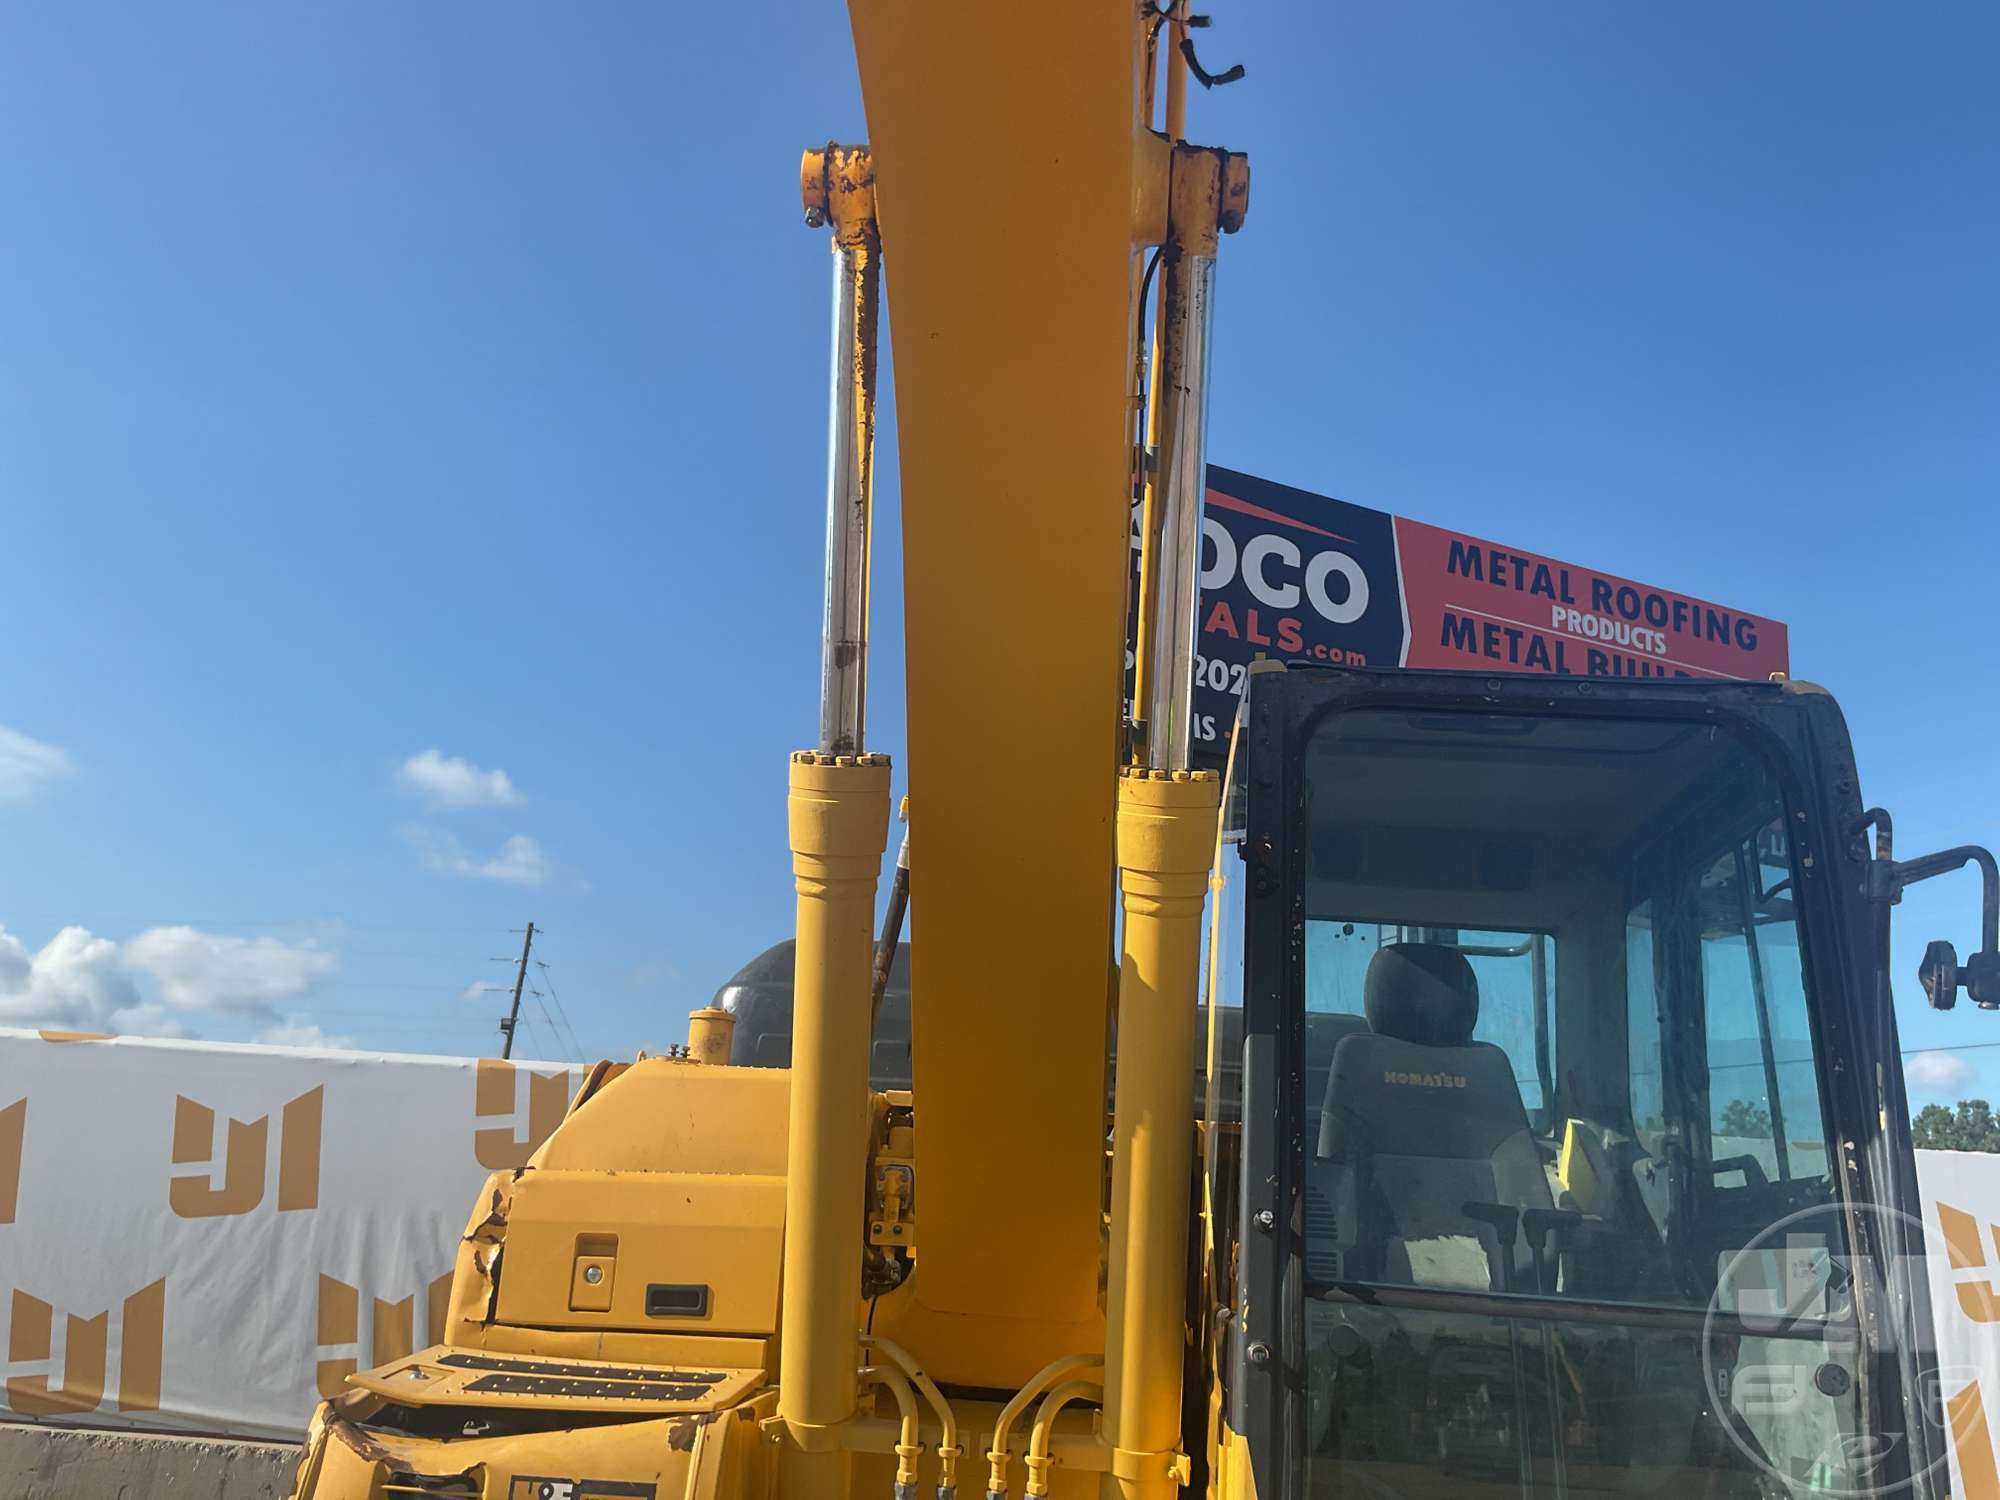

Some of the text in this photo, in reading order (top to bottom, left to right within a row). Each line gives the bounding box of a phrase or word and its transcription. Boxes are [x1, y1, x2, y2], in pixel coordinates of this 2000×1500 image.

[1447, 540, 1758, 651] METAL ROOFING
[1441, 612, 1570, 675] METAL
[1551, 605, 1667, 655] PRODUCTS
[1384, 1071, 1467, 1088] KOMATSU
